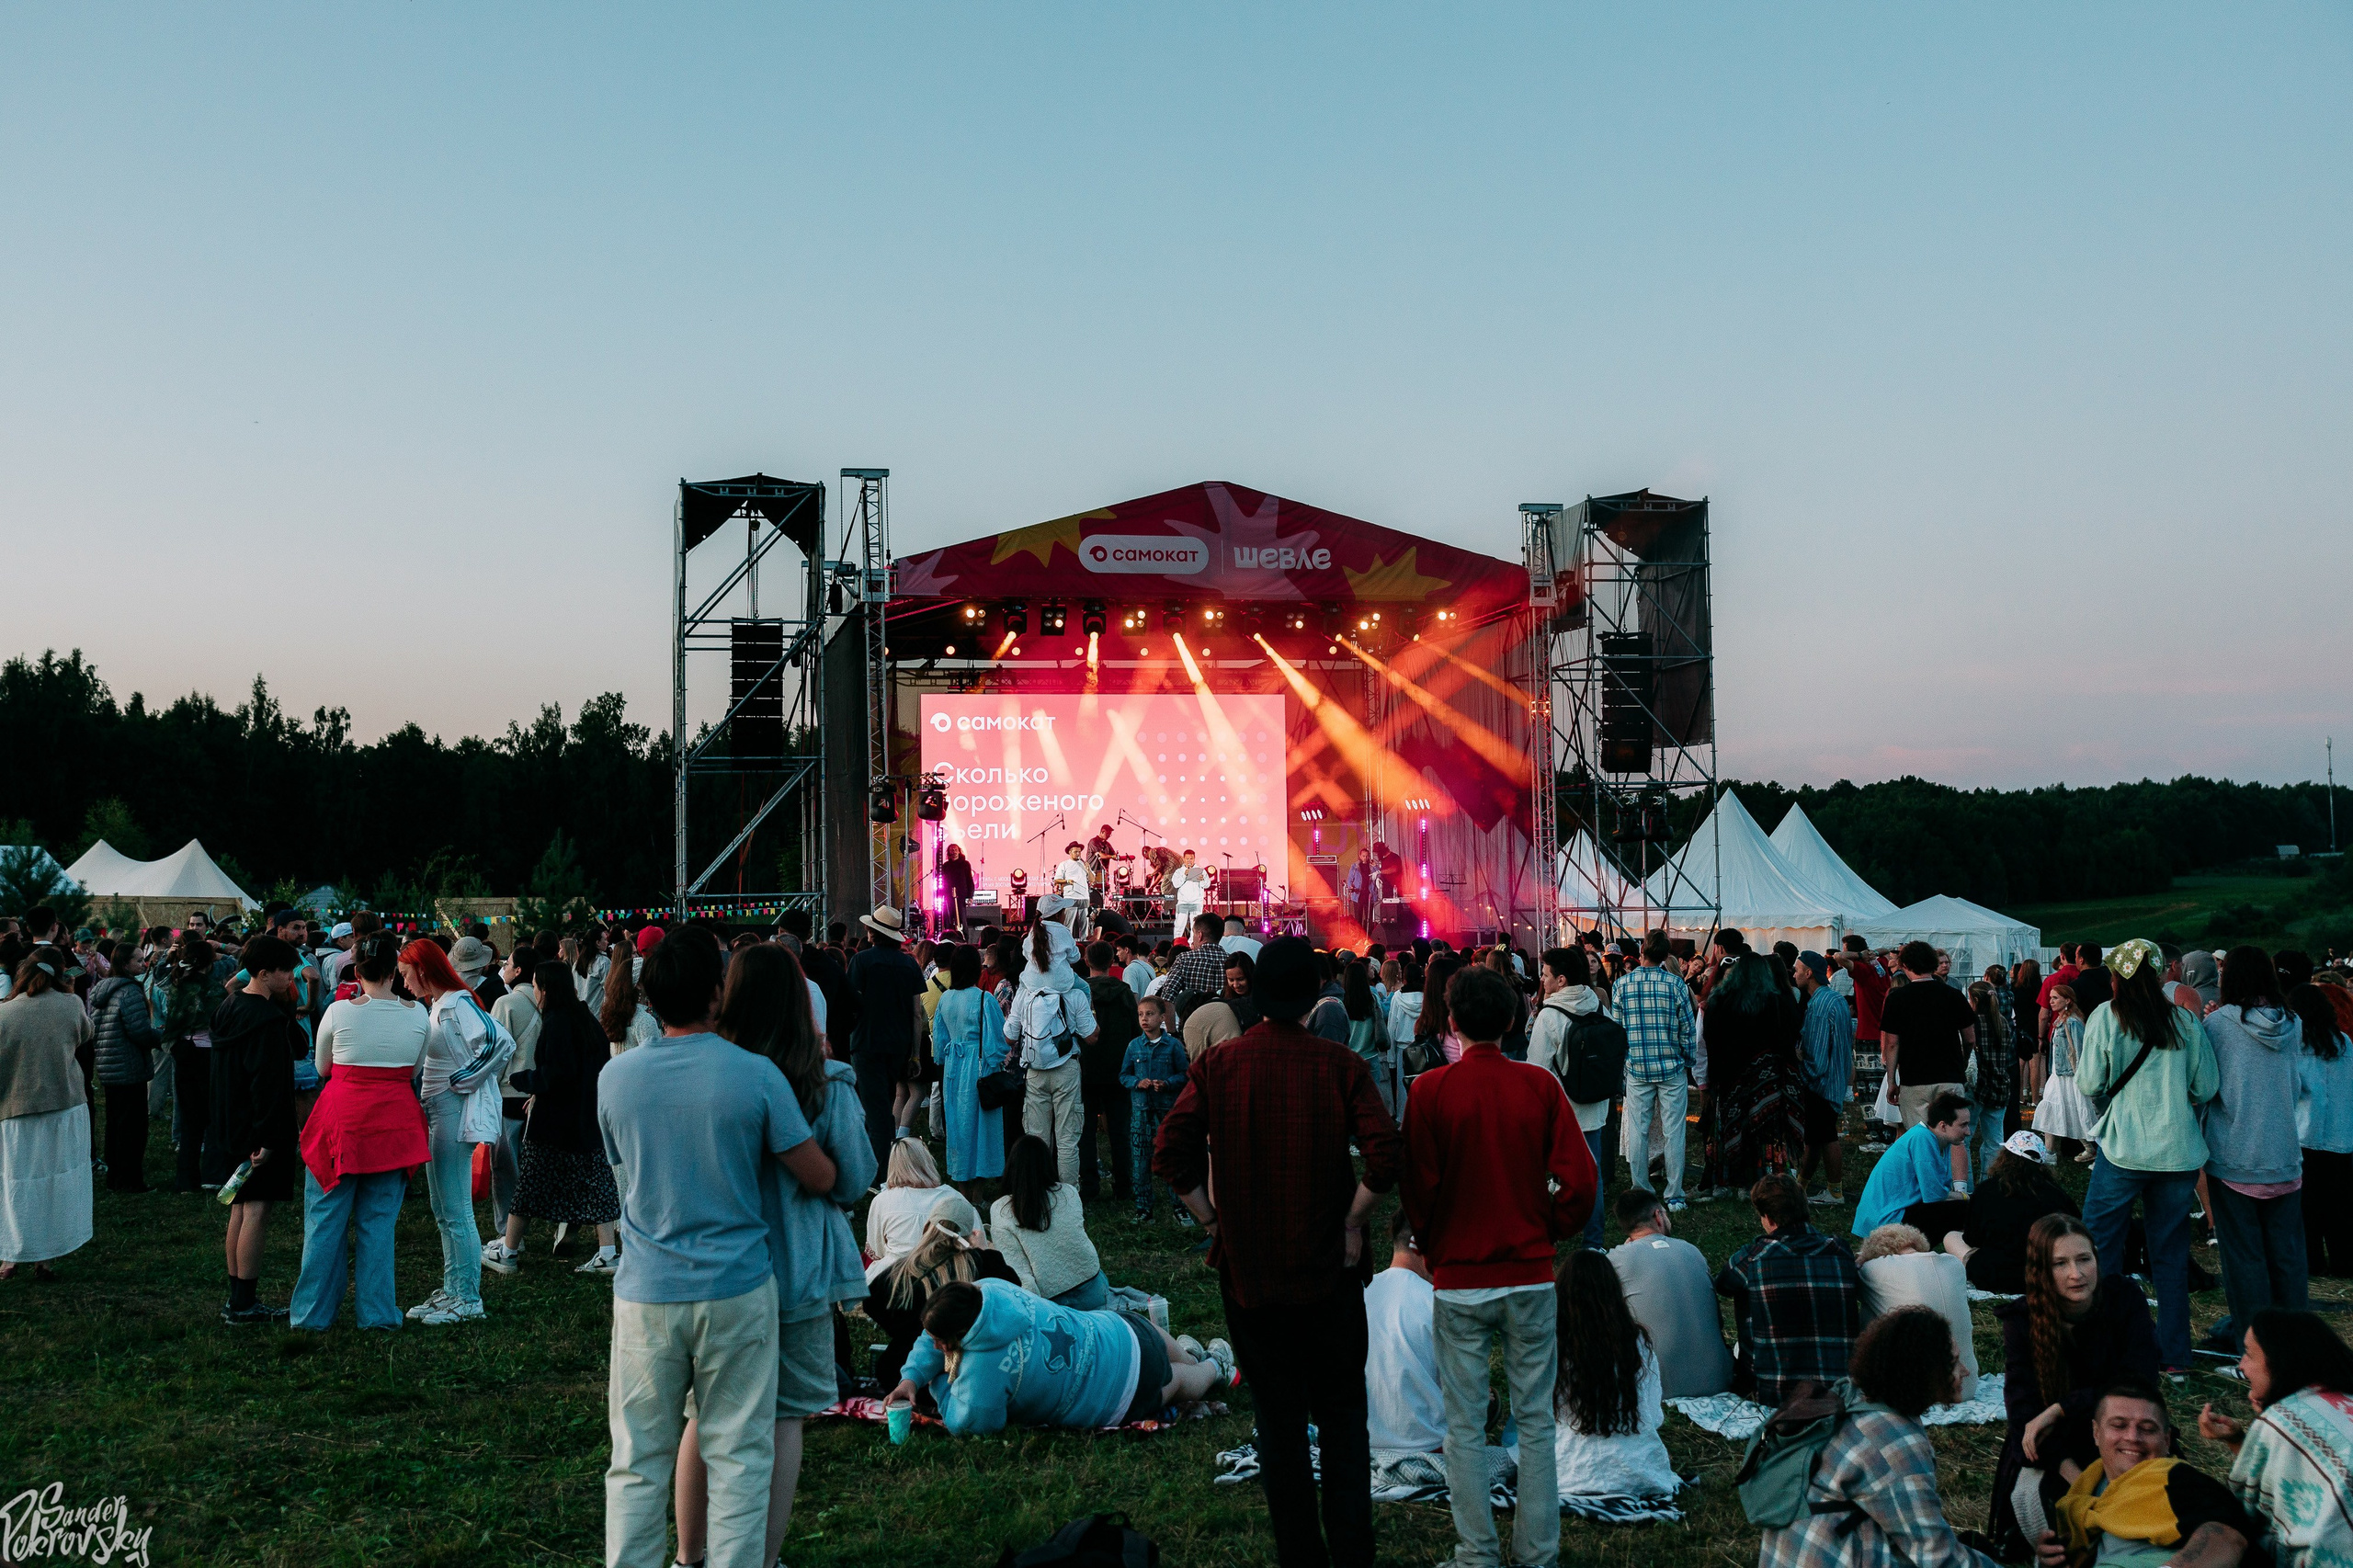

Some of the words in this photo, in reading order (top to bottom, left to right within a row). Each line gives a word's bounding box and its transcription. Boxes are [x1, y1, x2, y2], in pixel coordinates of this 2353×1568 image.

[1112, 549, 1199, 562] самокат
[957, 715, 1056, 731] самокат
[933, 761, 1049, 784] Сколько
[944, 793, 1105, 817] ороженого
